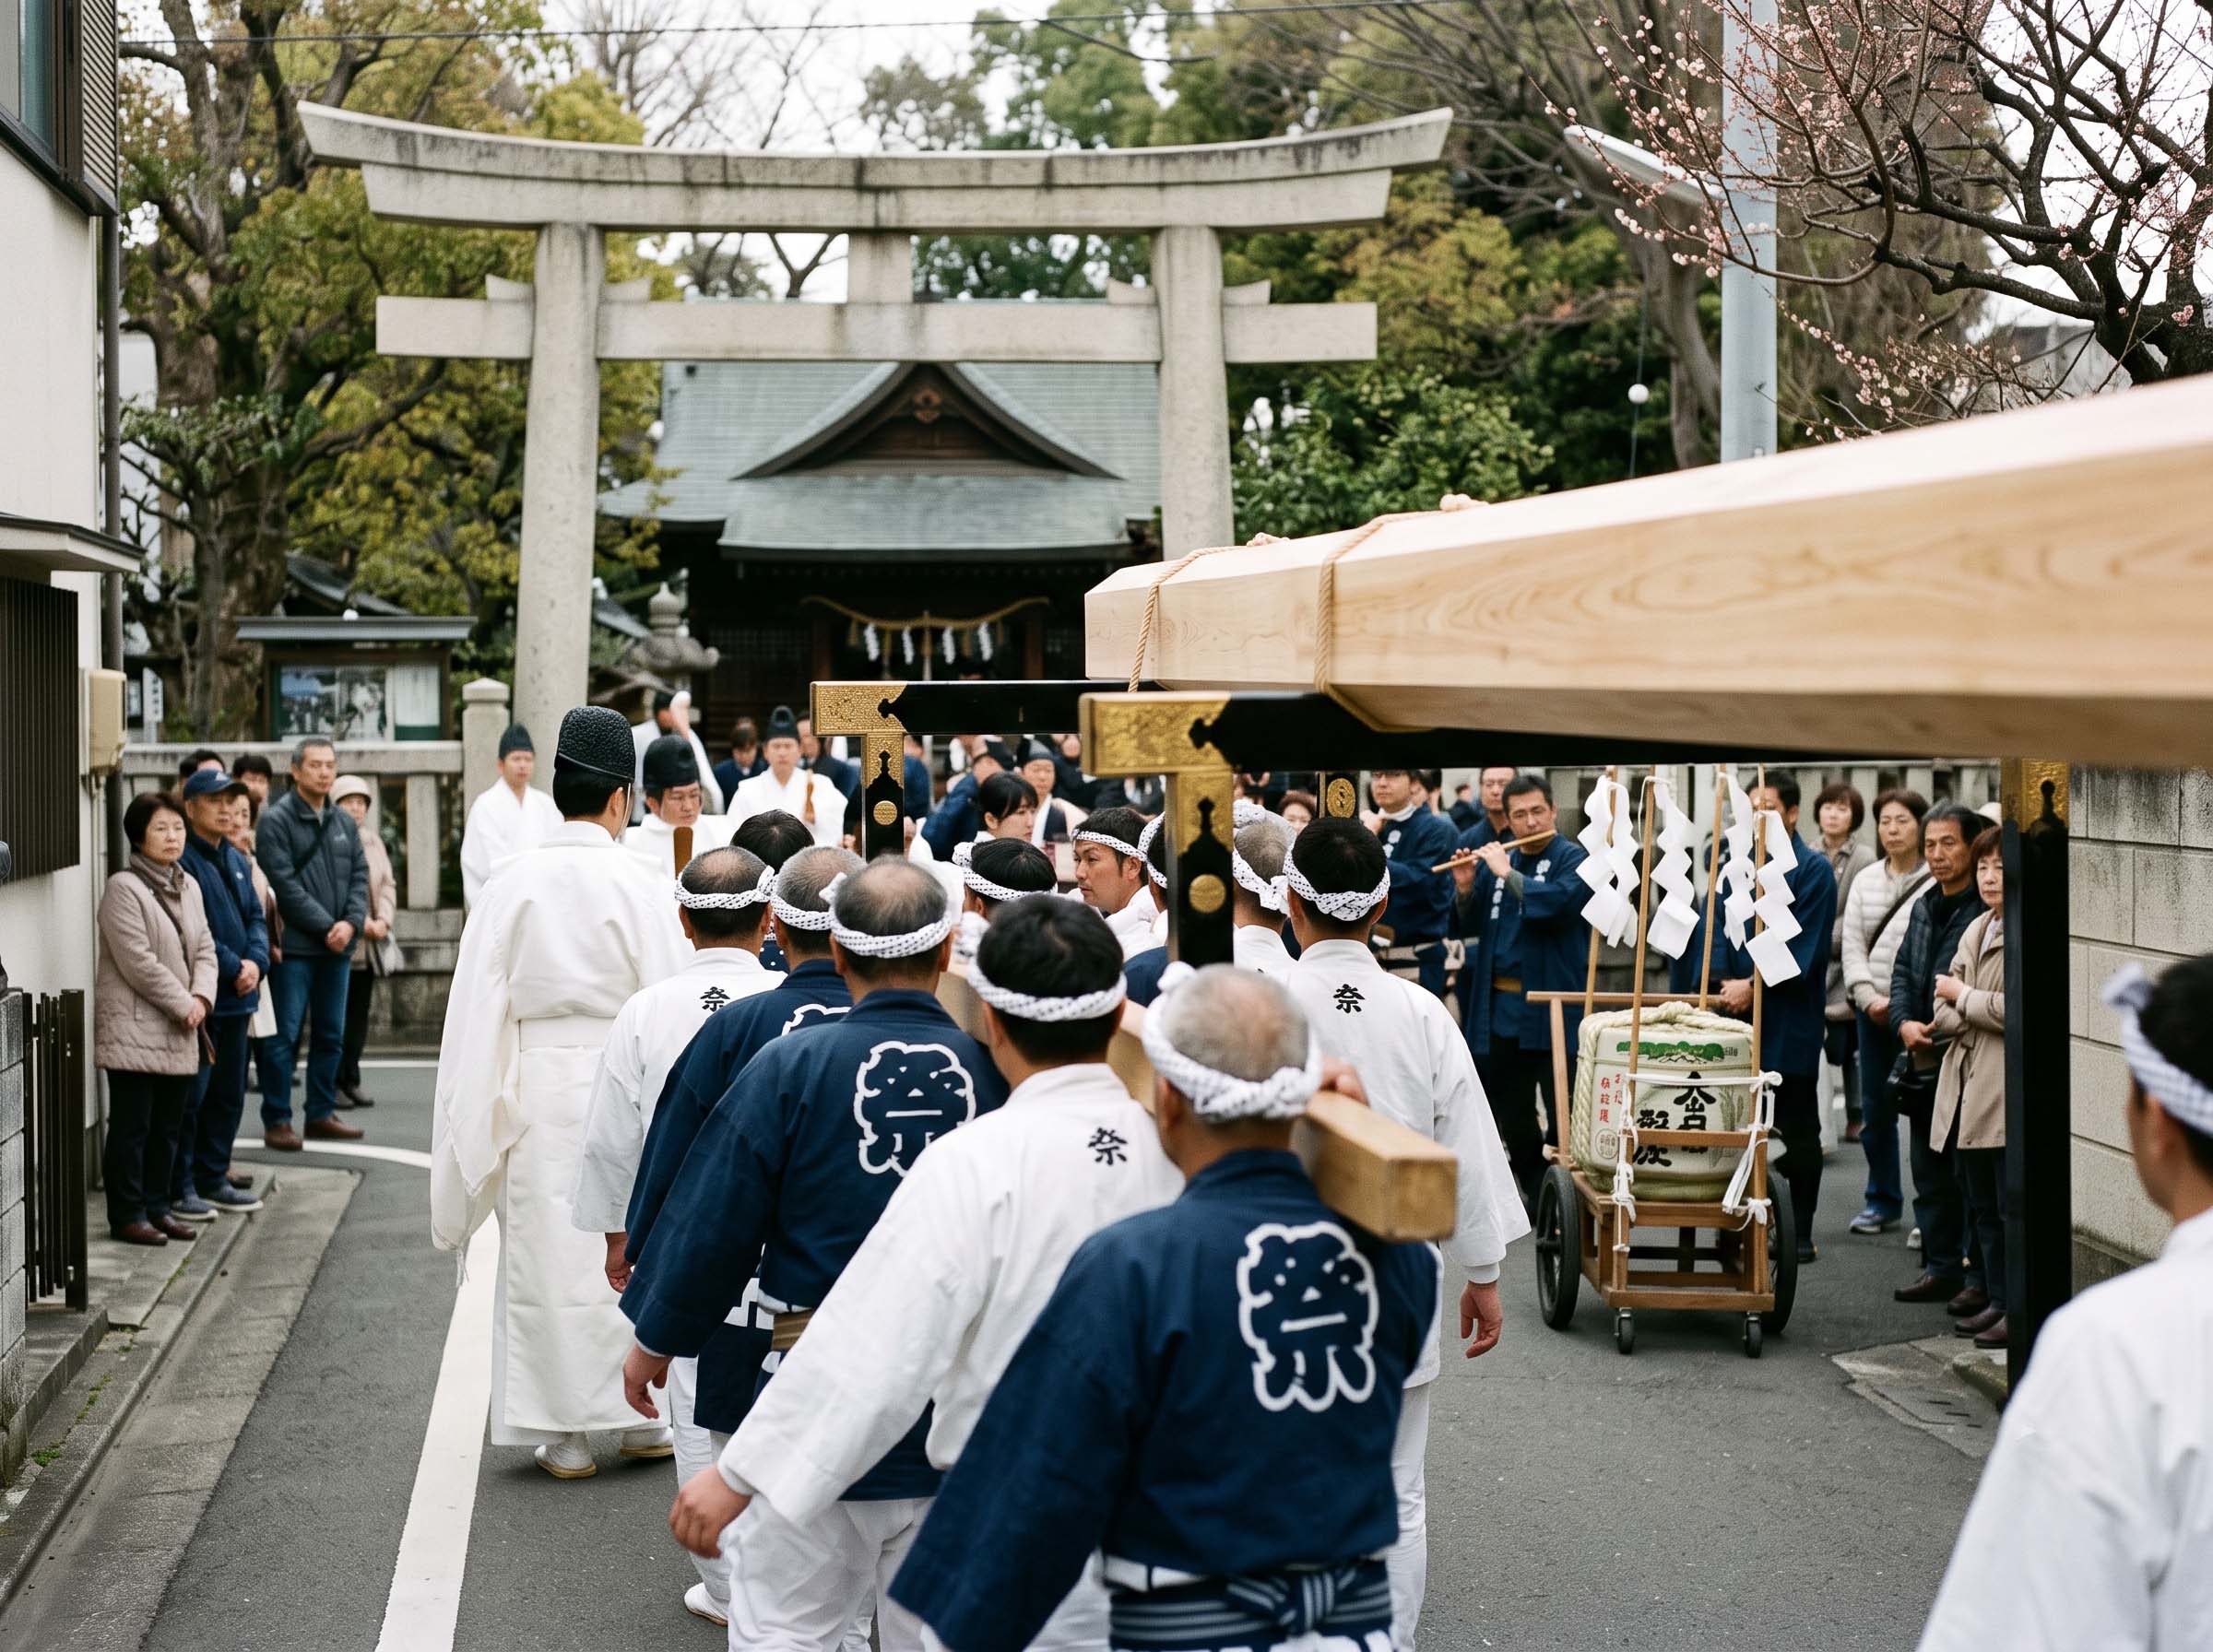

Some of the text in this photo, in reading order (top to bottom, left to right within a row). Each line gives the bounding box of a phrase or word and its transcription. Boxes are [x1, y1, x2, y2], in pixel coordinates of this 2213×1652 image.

[700, 986, 730, 1012] 祭
[1333, 984, 1365, 1013] 祭
[1087, 1127, 1128, 1166] 祭
